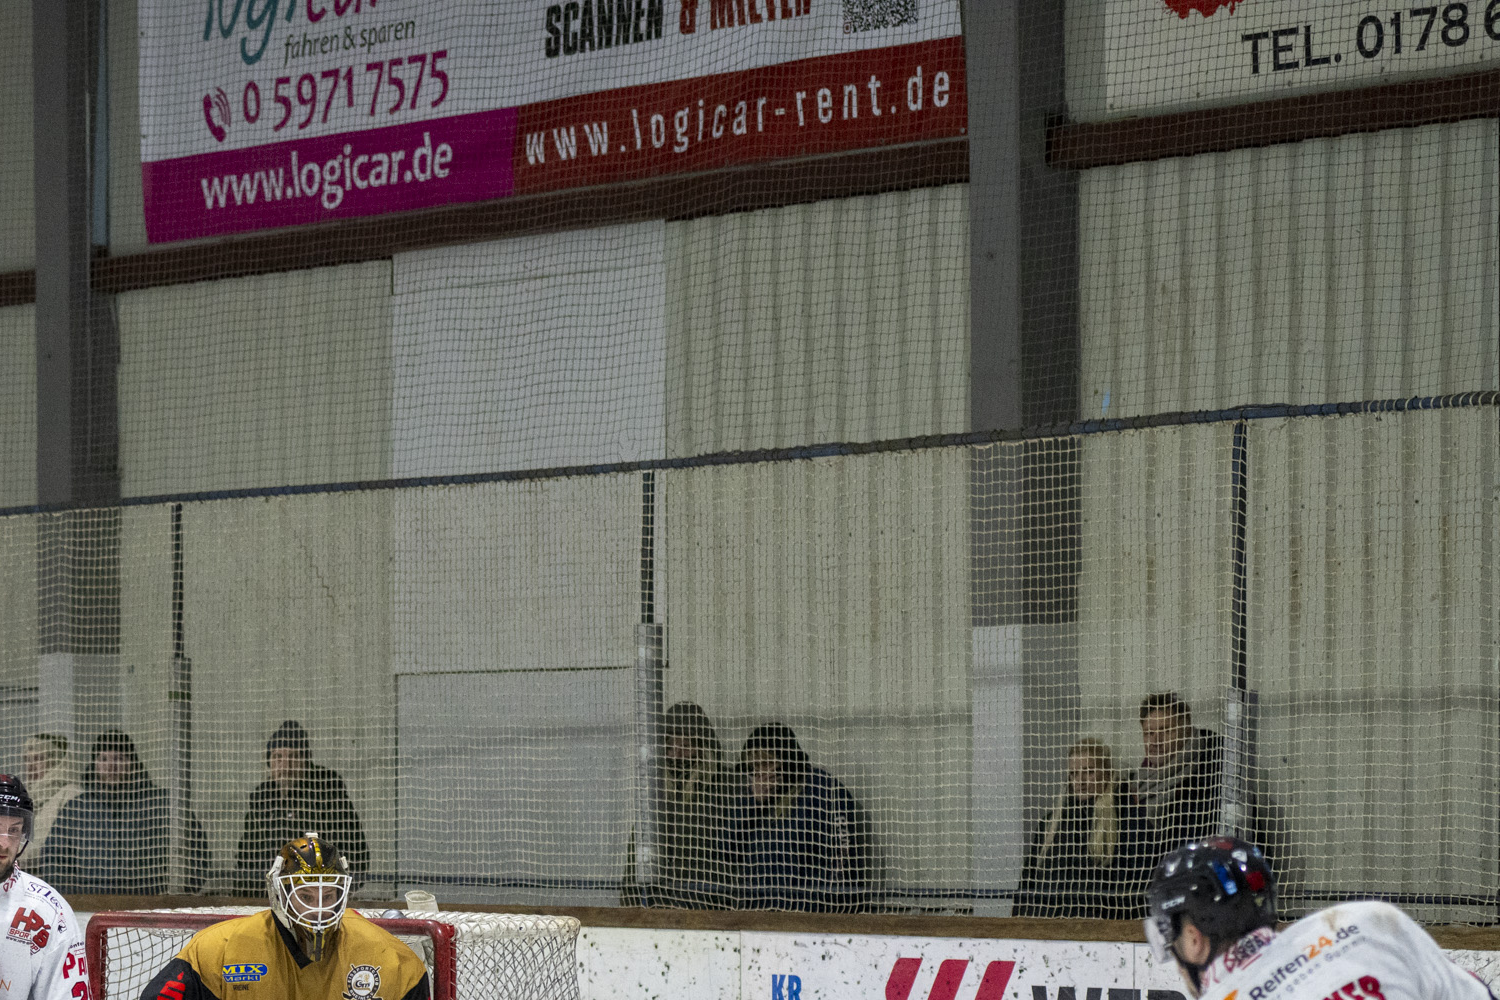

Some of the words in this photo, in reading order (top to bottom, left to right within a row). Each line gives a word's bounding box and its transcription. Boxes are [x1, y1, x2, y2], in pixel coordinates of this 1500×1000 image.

[284, 32, 340, 68] fahren
[342, 26, 356, 51] &
[359, 19, 416, 54] sparen
[545, 0, 663, 59] SCANNEN
[1241, 25, 1342, 75] TEL.
[1356, 2, 1470, 59] 0178
[242, 81, 261, 124] 0
[273, 66, 355, 132] 5971
[366, 50, 449, 117] 7575
[525, 65, 951, 166] www.logicar-rent.de
[200, 131, 453, 210] www.logicar.de
[222, 965, 264, 974] MIX
